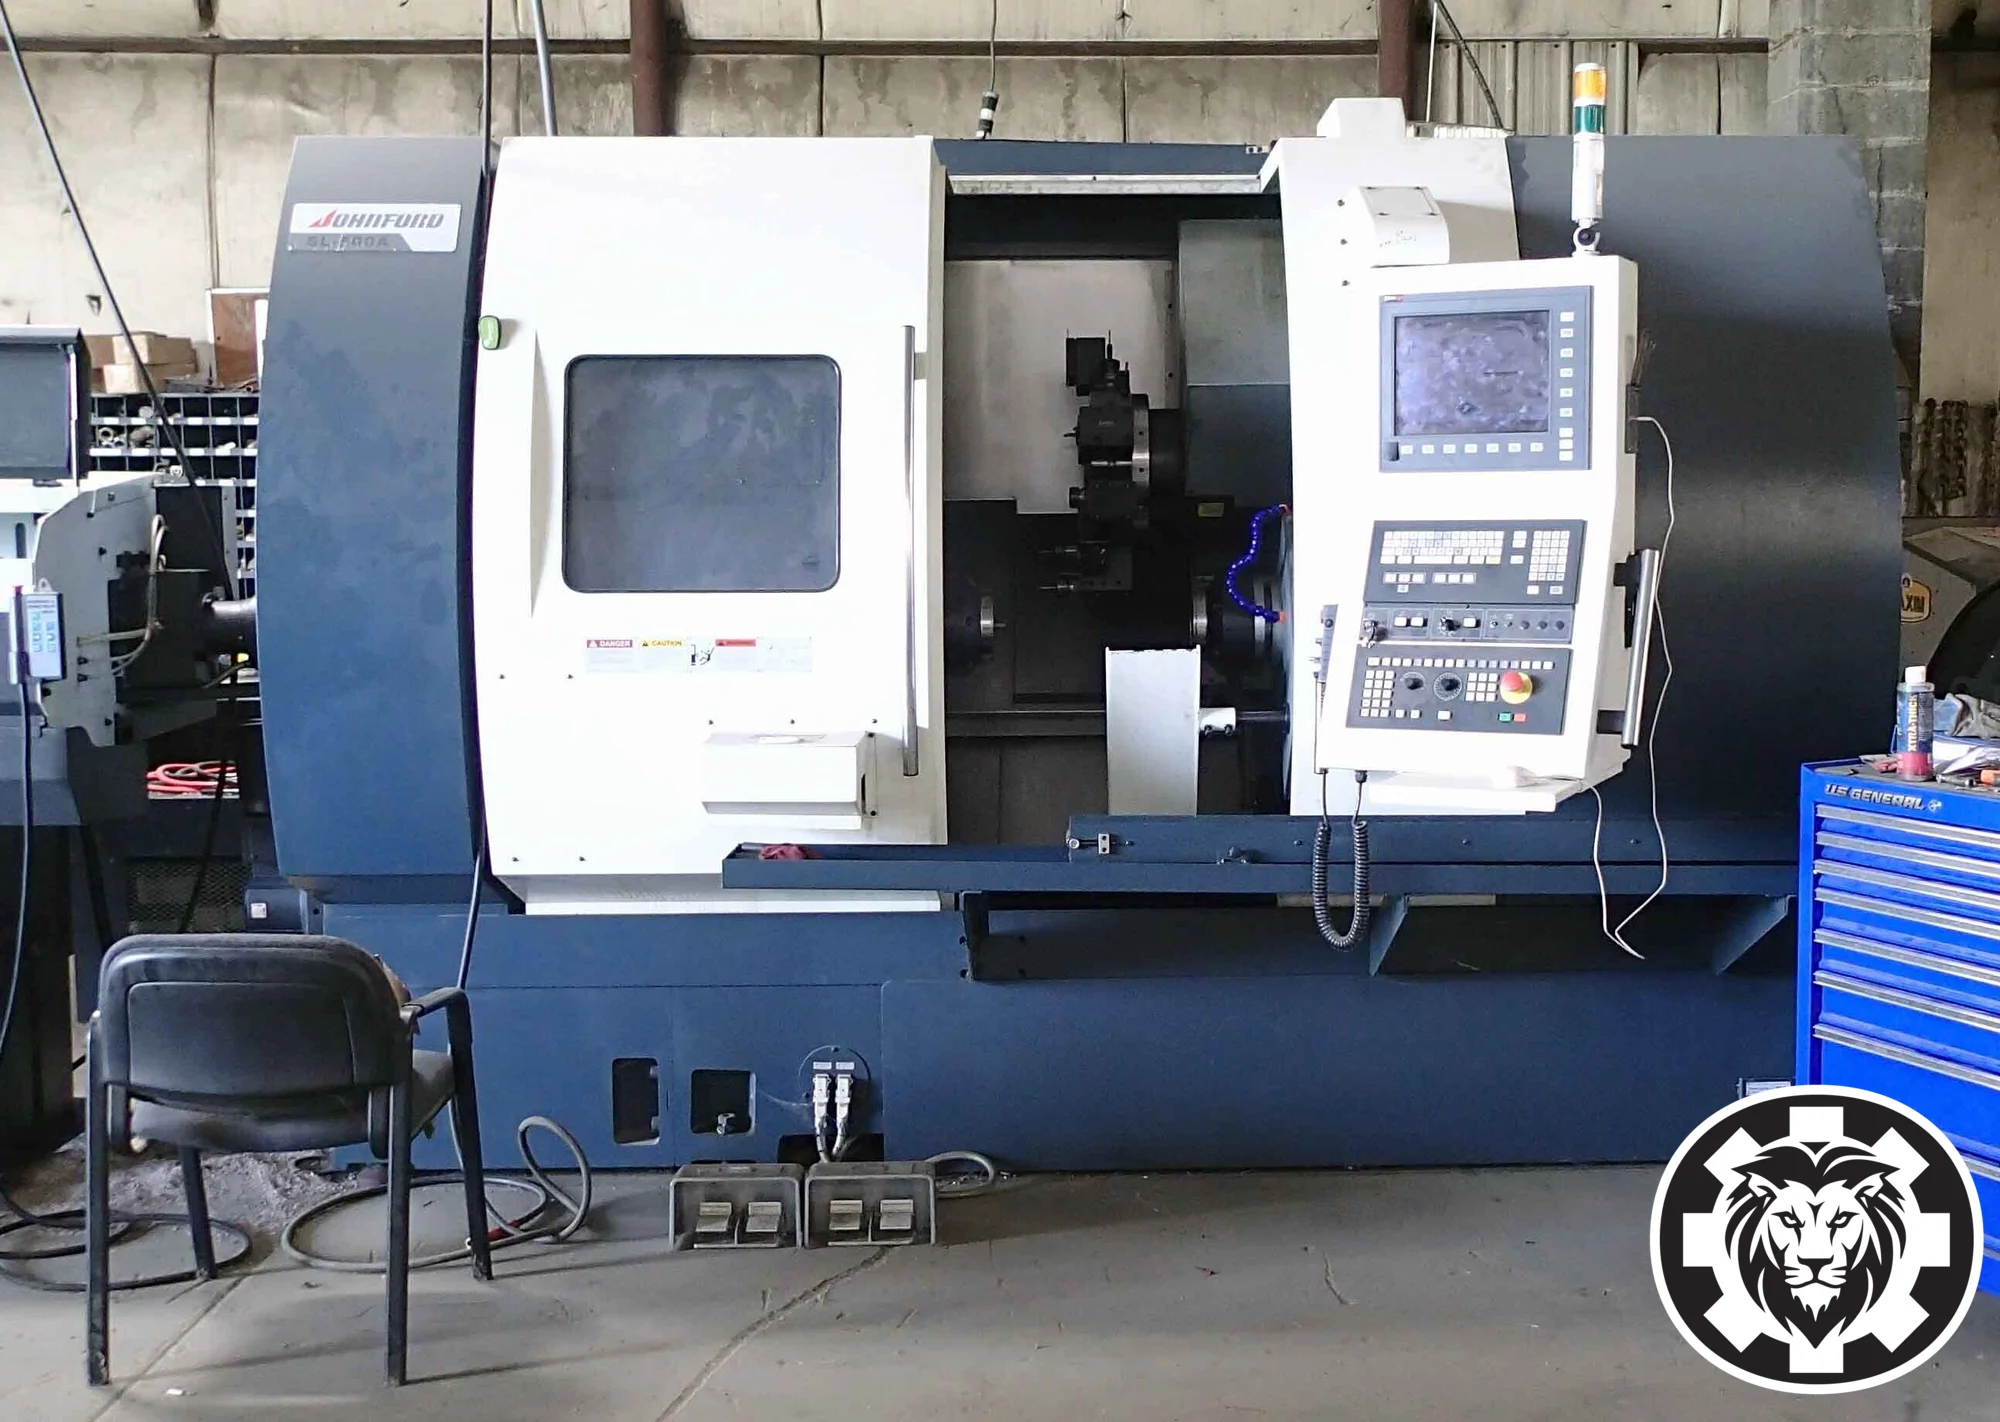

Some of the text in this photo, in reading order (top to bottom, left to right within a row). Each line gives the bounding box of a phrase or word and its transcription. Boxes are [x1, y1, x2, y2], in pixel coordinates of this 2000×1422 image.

[308, 207, 445, 229] JOHNFORD
[600, 640, 632, 648] DANGER
[652, 639, 682, 647] CAUTION
[1850, 788, 1925, 811] GENERAL
